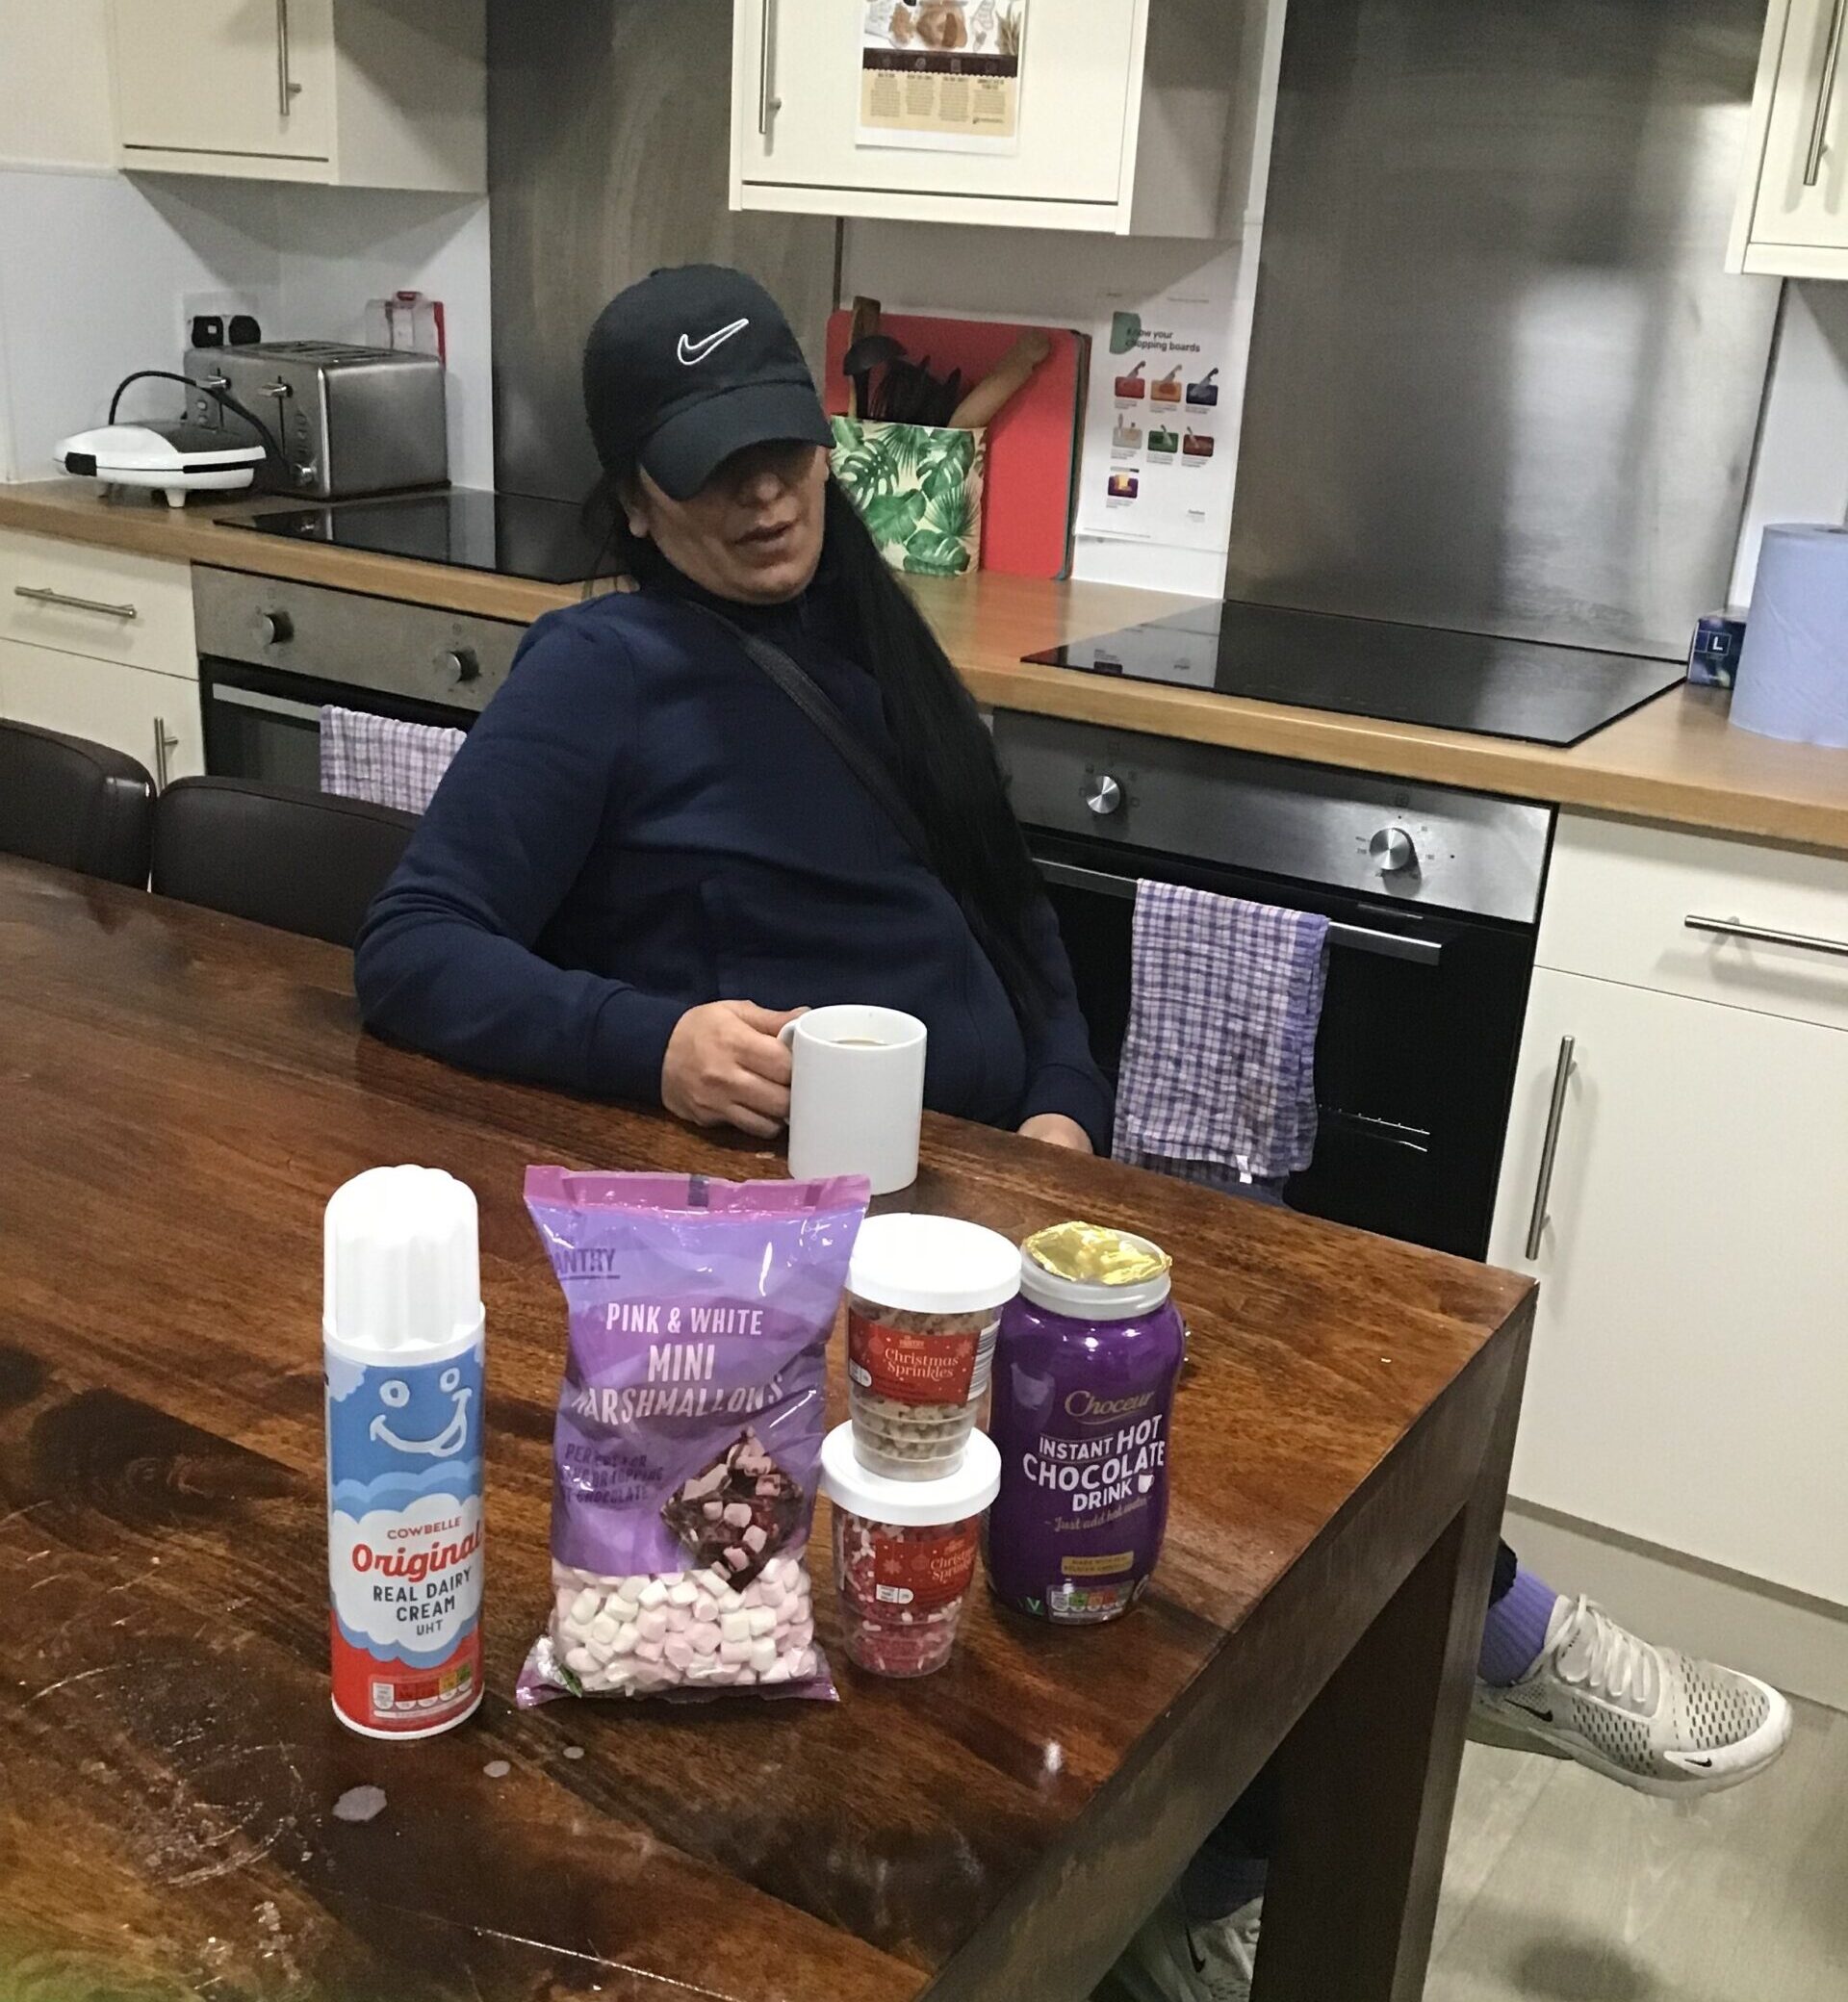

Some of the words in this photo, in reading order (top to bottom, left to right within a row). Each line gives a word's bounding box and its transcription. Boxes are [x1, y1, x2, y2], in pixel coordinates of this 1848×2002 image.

[1154, 331, 1173, 341] your
[1169, 342, 1201, 353] boards
[1712, 636, 1723, 651] L
[605, 1302, 660, 1334] PINK
[667, 1306, 681, 1334] &
[690, 1307, 763, 1336] WHITE
[647, 1342, 716, 1383] MINI
[885, 1348, 960, 1367] Christmas
[887, 1360, 955, 1382] Sprinkles
[1065, 1390, 1155, 1420] Choceur
[1040, 1434, 1113, 1461] INSTANT
[1116, 1414, 1163, 1455] HOT
[1023, 1440, 1166, 1492] CHOCOLATE
[1072, 1477, 1133, 1513] DRINK
[387, 1516, 462, 1540] COWBELLE
[1054, 1516, 1080, 1532] Just
[352, 1520, 481, 1583] Original
[372, 1584, 419, 1603] REAL
[426, 1566, 472, 1600] DAIRY
[397, 1595, 455, 1622] CREAM
[416, 1619, 444, 1636] UHT
